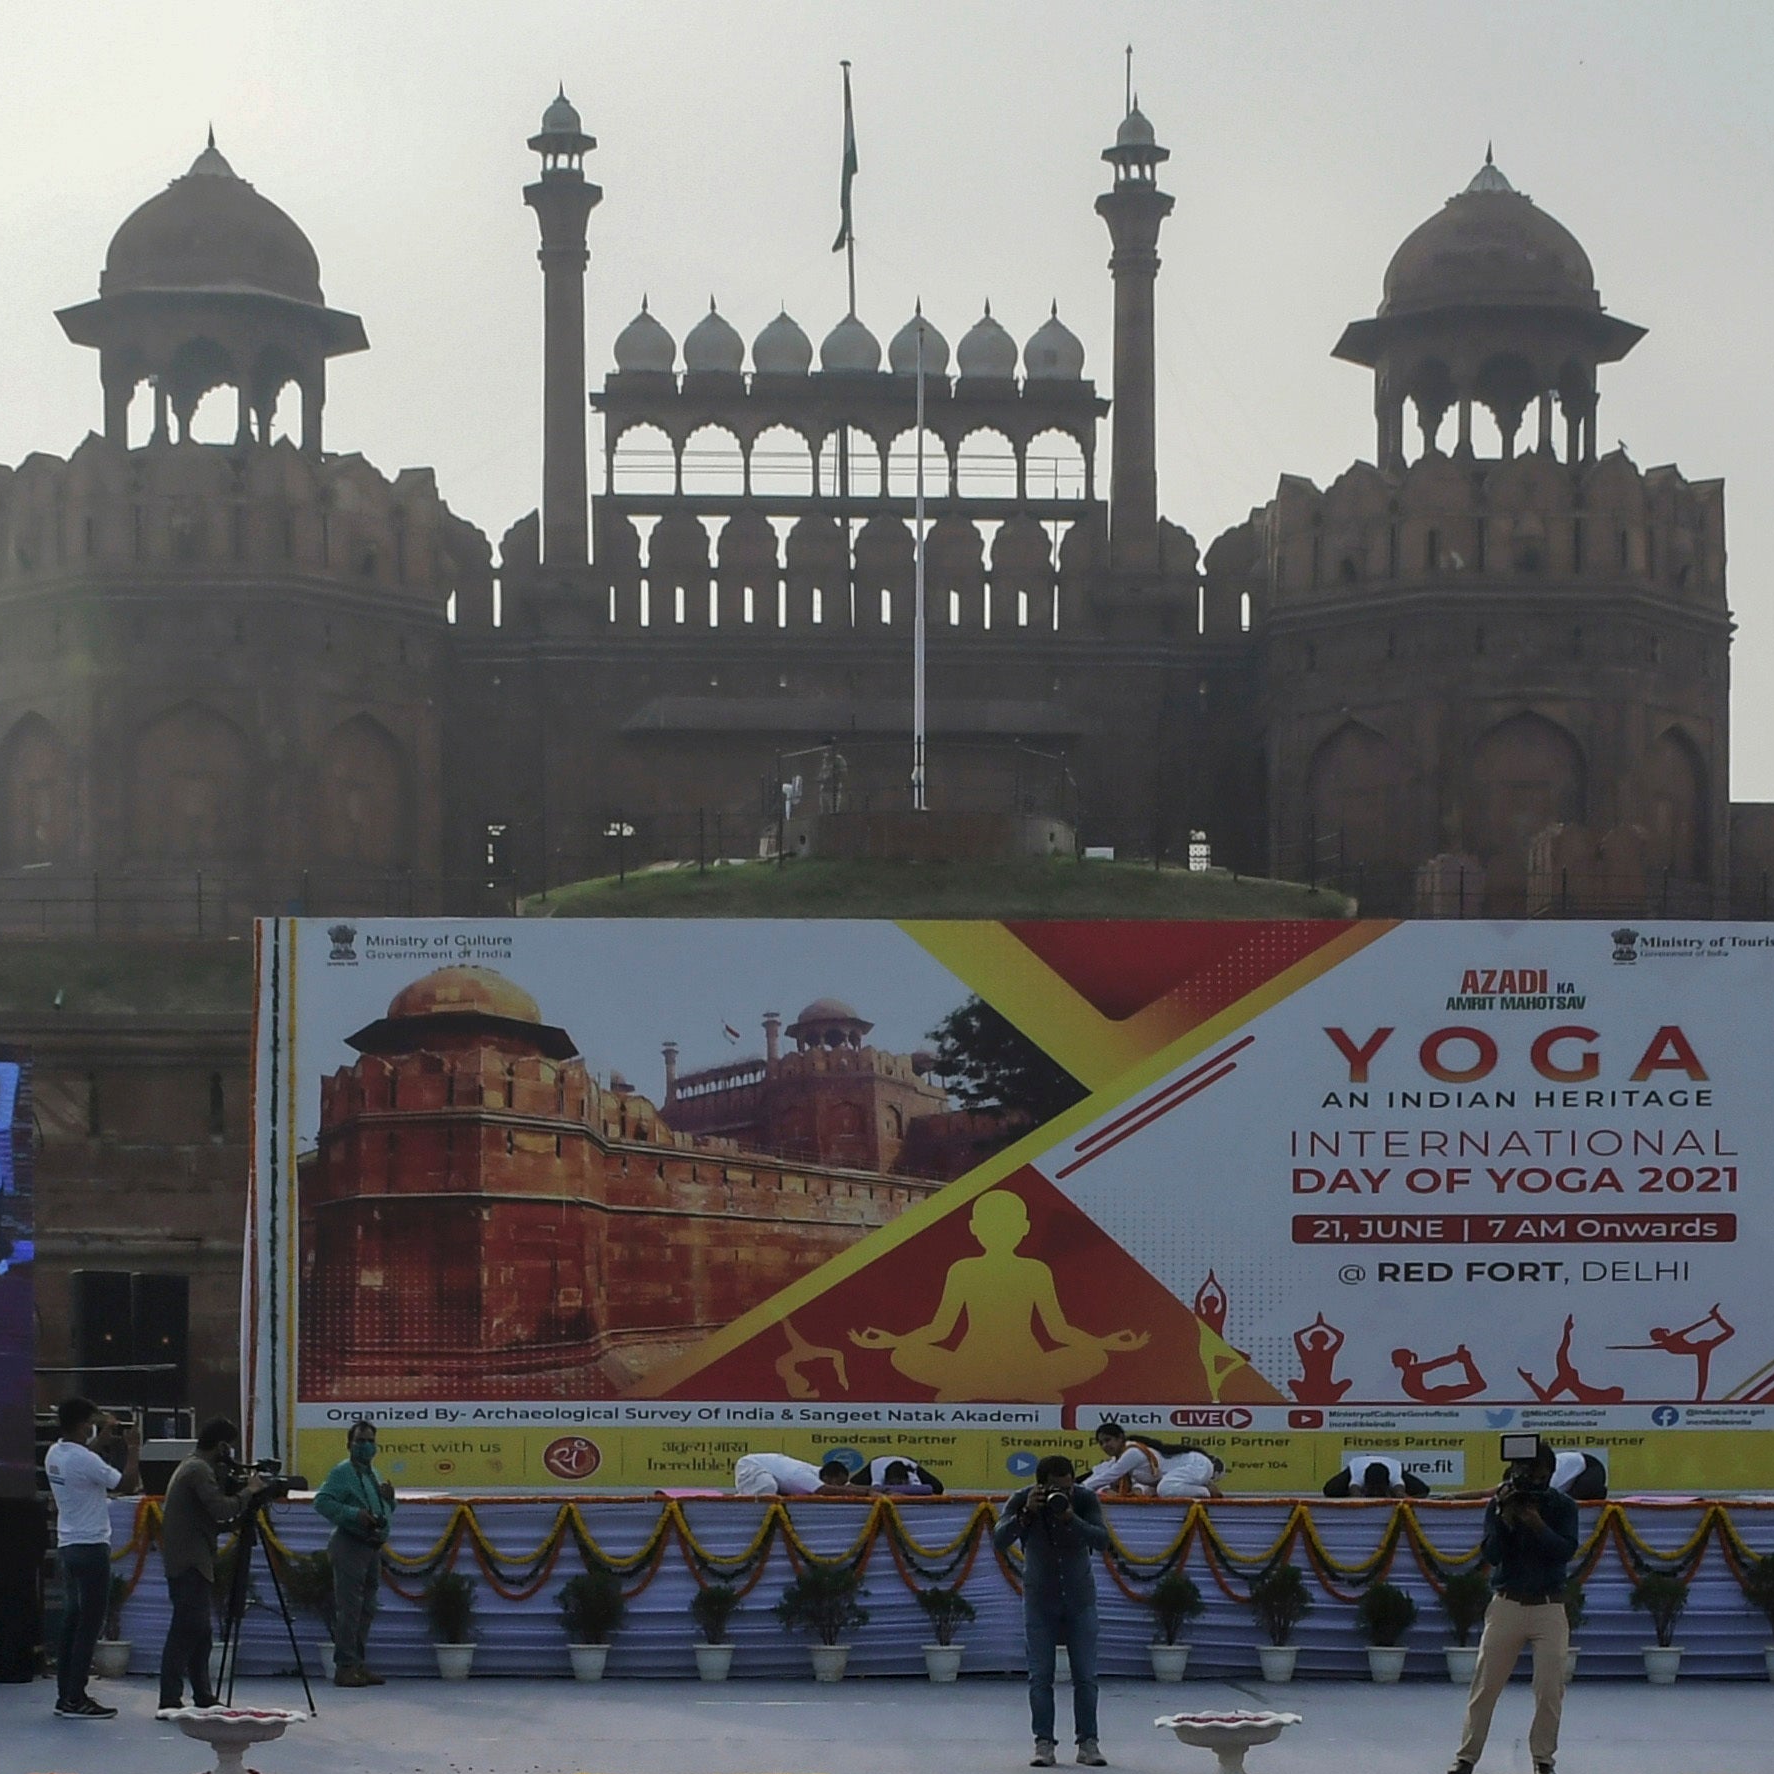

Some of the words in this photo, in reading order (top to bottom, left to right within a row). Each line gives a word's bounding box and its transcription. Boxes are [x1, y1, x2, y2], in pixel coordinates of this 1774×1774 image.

[366, 935, 427, 948] Ministry
[433, 935, 448, 946] of
[454, 934, 513, 946] Culture
[1640, 937, 1703, 949] Ministry
[1709, 936, 1725, 947] of
[366, 949, 452, 960] Government
[457, 950, 471, 960] of
[477, 949, 512, 959] India
[1460, 969, 1548, 995] AZADI
[1557, 982, 1575, 994] KA
[1446, 997, 1496, 1011] AMRIT
[1500, 996, 1586, 1011] MAHOTSAV
[1322, 1025, 1710, 1084] YOGA
[1321, 1091, 1369, 1109] AN
[1388, 1091, 1516, 1109] INDIAN
[1534, 1089, 1712, 1108] HERITAGE
[1291, 1129, 1738, 1157] INTERNATIONAL
[1292, 1168, 1391, 1194] DAY
[1405, 1168, 1472, 1194] OF
[1485, 1167, 1624, 1193] YOGA
[1638, 1166, 1738, 1193] 2021
[1313, 1220, 1349, 1241] 21,
[1358, 1219, 1444, 1239] JUNE
[1488, 1219, 1504, 1239] 7
[1515, 1219, 1566, 1239] AM
[1576, 1218, 1718, 1239] Onwards
[1338, 1264, 1366, 1283] @
[1377, 1262, 1453, 1282] RED
[1466, 1262, 1569, 1284] FORT,
[1582, 1260, 1690, 1282] DELHI
[327, 1408, 429, 1423] Organized
[435, 1408, 468, 1423] By-
[473, 1407, 620, 1422] Archaeological
[625, 1408, 690, 1422] Survey
[697, 1407, 721, 1421] Of
[726, 1407, 775, 1421] India
[780, 1408, 795, 1422] &
[799, 1407, 882, 1424] Sangeet
[887, 1408, 947, 1422] Natak
[951, 1409, 1040, 1423] Akademi
[1099, 1411, 1162, 1425] Watch
[1177, 1411, 1222, 1426] LIVE
[377, 1440, 426, 1454] nnect
[432, 1440, 474, 1454] with
[479, 1444, 502, 1454] us
[811, 1434, 892, 1444] Broadcast
[898, 1434, 958, 1445] Partner
[1001, 1436, 1084, 1450] Streaming
[1181, 1436, 1226, 1447] Radio
[1231, 1437, 1290, 1448] Partner
[1343, 1436, 1400, 1447] Fitness
[1405, 1436, 1465, 1447] Partner
[1542, 1436, 1580, 1446] strial
[1585, 1436, 1645, 1446] Partner
[1232, 1460, 1264, 1469] Fever
[1268, 1460, 1289, 1469] 104
[1401, 1459, 1454, 1474] ure.fit
